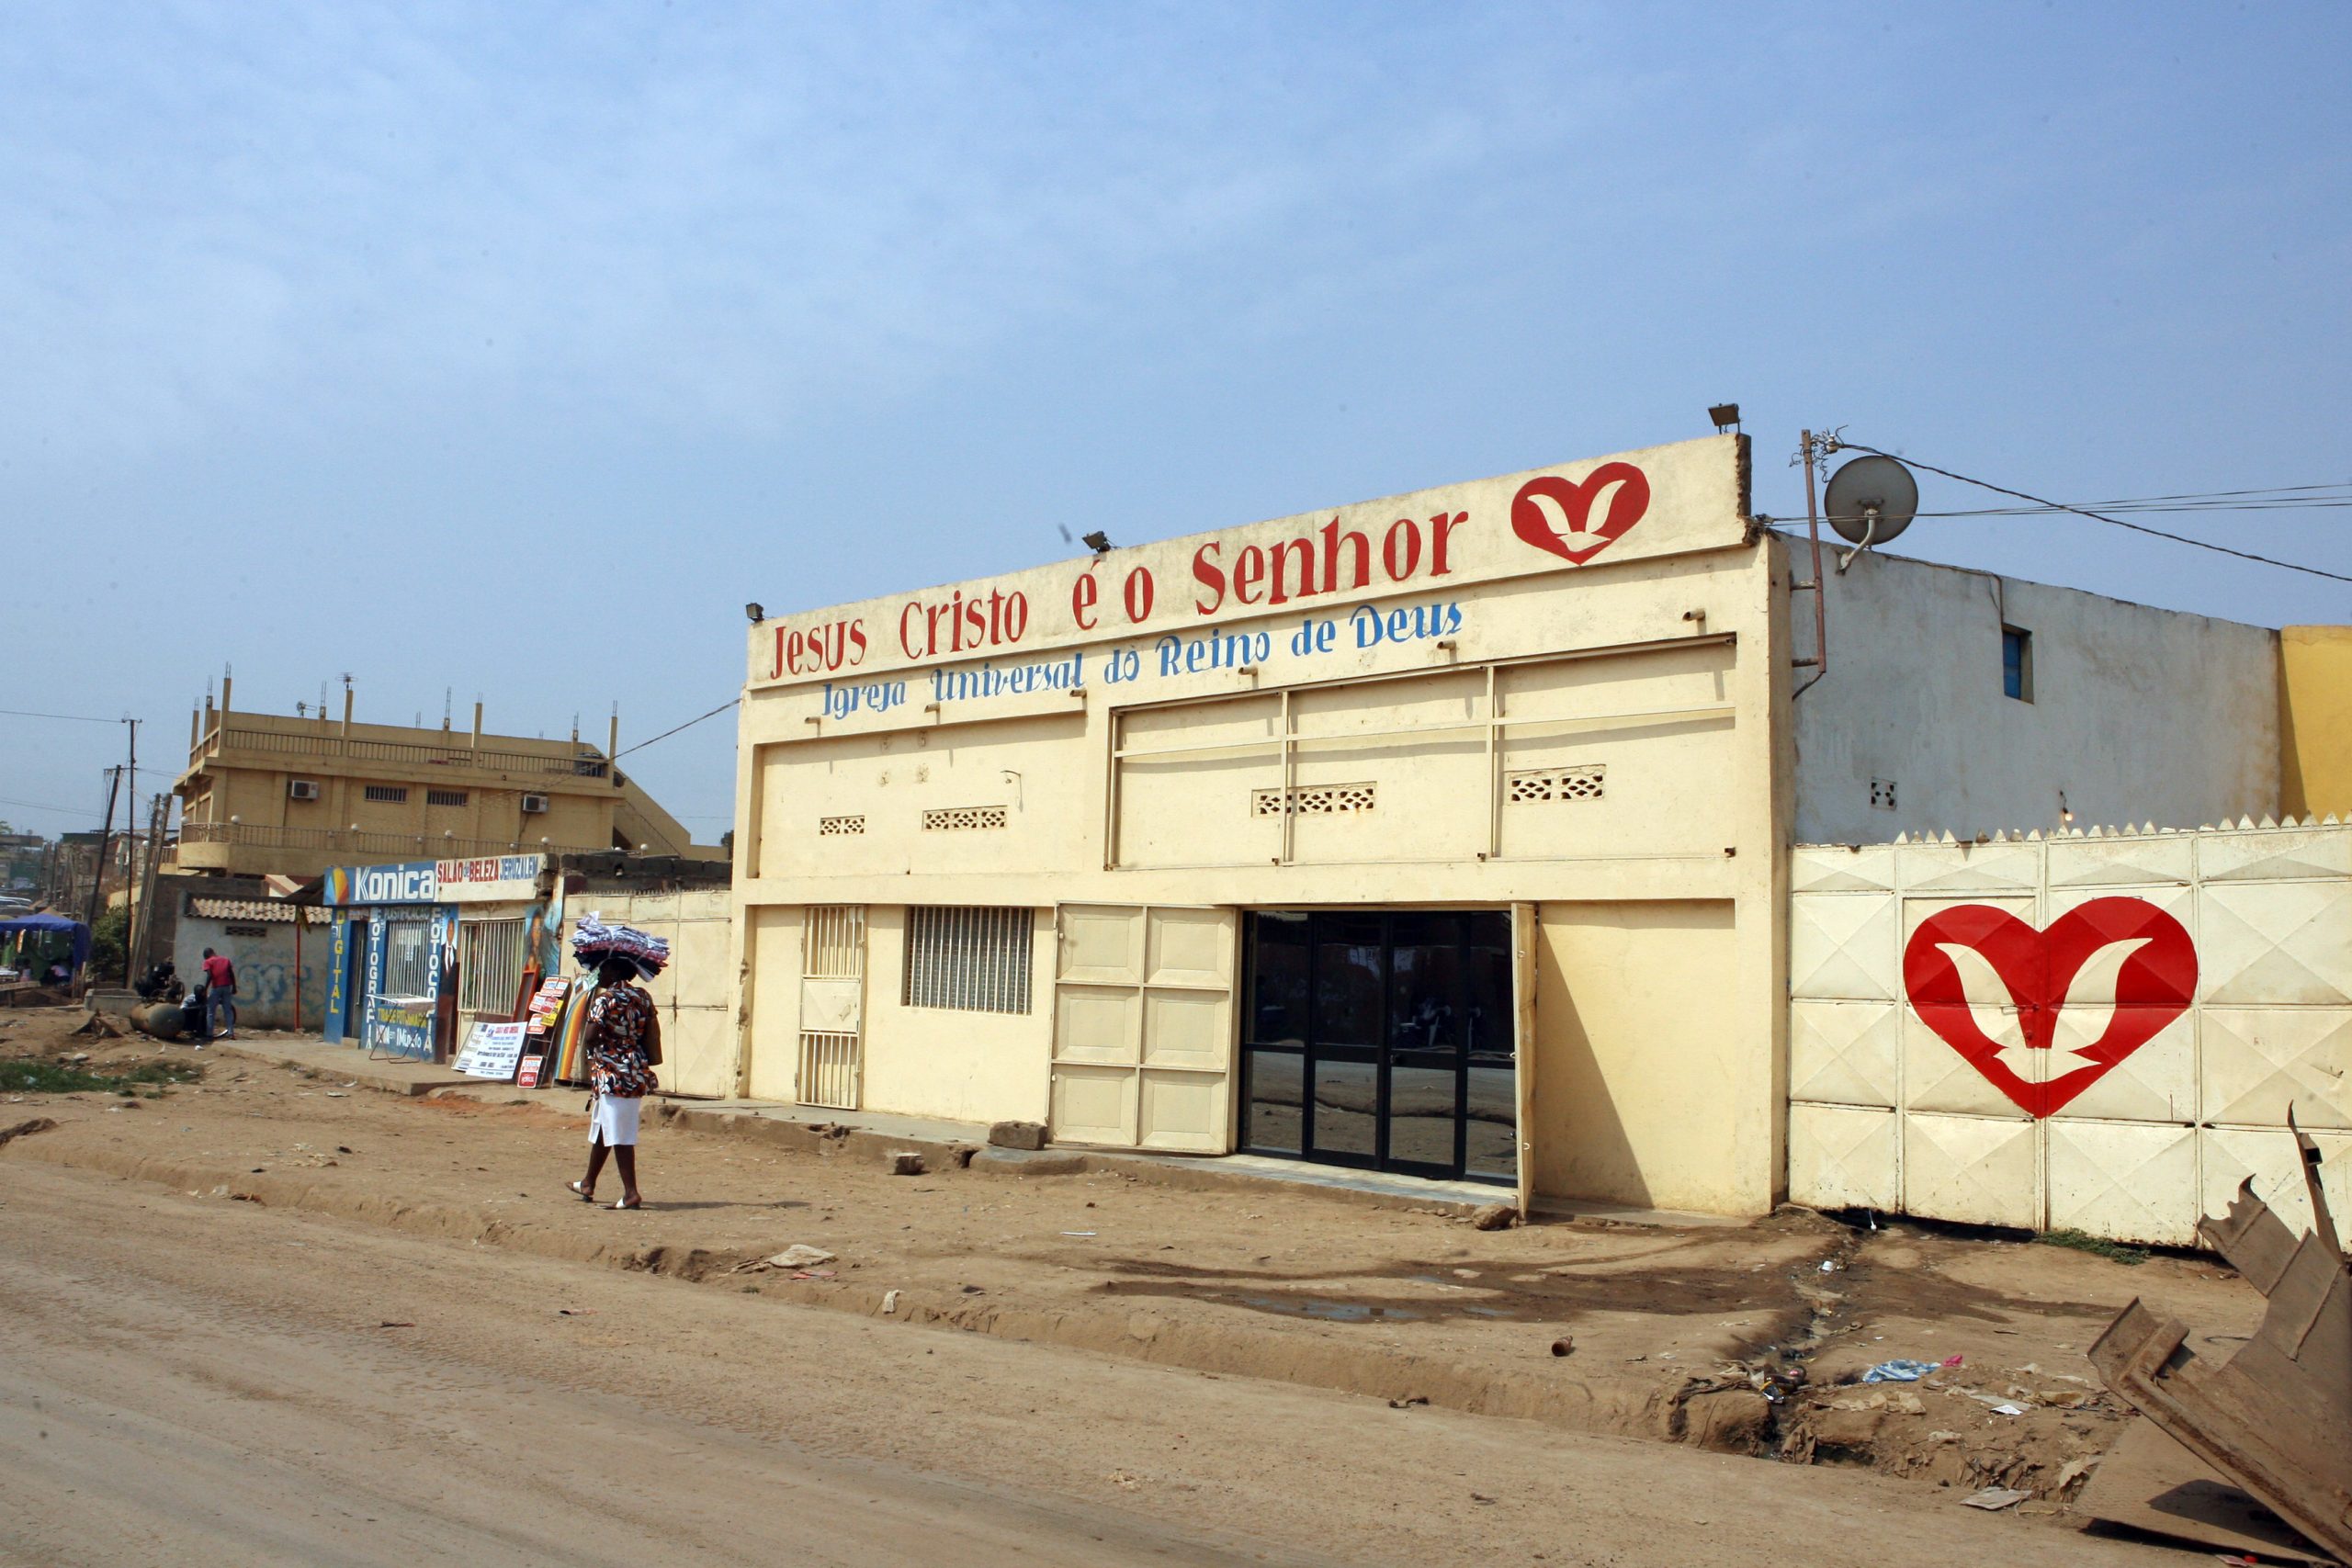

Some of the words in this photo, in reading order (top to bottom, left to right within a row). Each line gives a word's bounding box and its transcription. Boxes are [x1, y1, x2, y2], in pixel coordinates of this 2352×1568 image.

[770, 618, 866, 680] Jesus
[899, 586, 1028, 660] Cristo
[1072, 559, 1102, 631] é
[1124, 566, 1154, 624] o
[1192, 515, 1469, 616] Senhor
[822, 682, 906, 720] Igreja
[931, 652, 1084, 701] Universal
[1104, 649, 1140, 684] do
[1155, 628, 1271, 677] Reino
[1292, 619, 1336, 657] de
[1349, 602, 1463, 649] Deus
[354, 863, 435, 901] Konica
[469, 859, 499, 883] BELEZA
[331, 909, 346, 1014] DIGITAL
